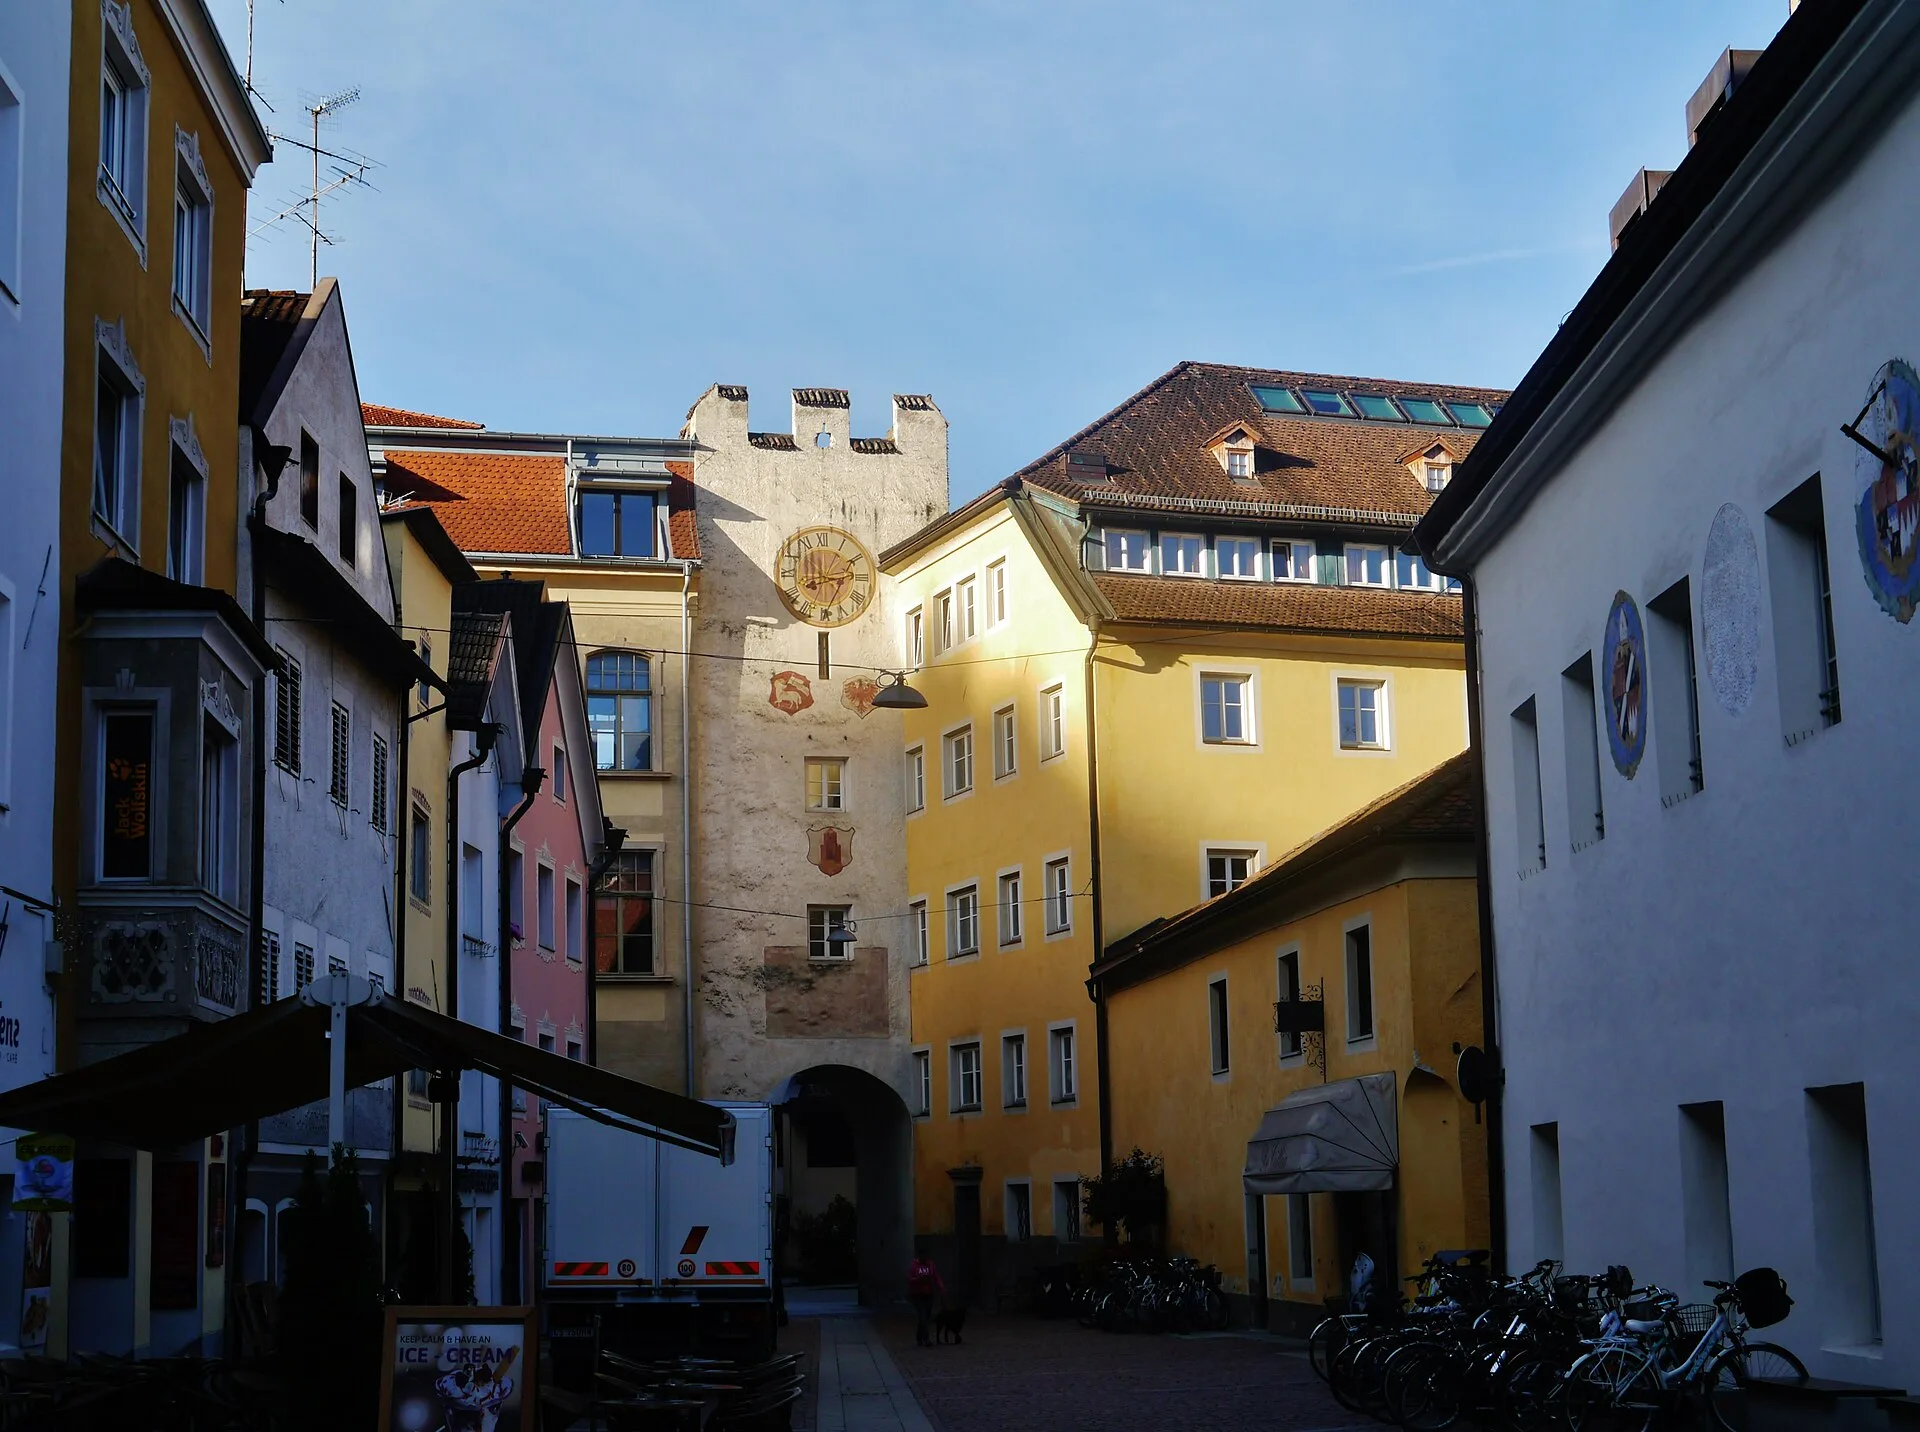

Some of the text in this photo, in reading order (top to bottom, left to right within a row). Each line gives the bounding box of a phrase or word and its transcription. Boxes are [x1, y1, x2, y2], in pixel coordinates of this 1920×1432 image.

[130, 763, 146, 840] Wolfskin
[114, 797, 130, 839] Jack
[621, 1263, 632, 1273] 80
[681, 1263, 692, 1273] 100
[400, 1335, 420, 1343] KEEP
[421, 1335, 445, 1343] CALM
[454, 1335, 478, 1343] HAVE
[478, 1335, 491, 1343] AN
[446, 1347, 513, 1364] CREAM
